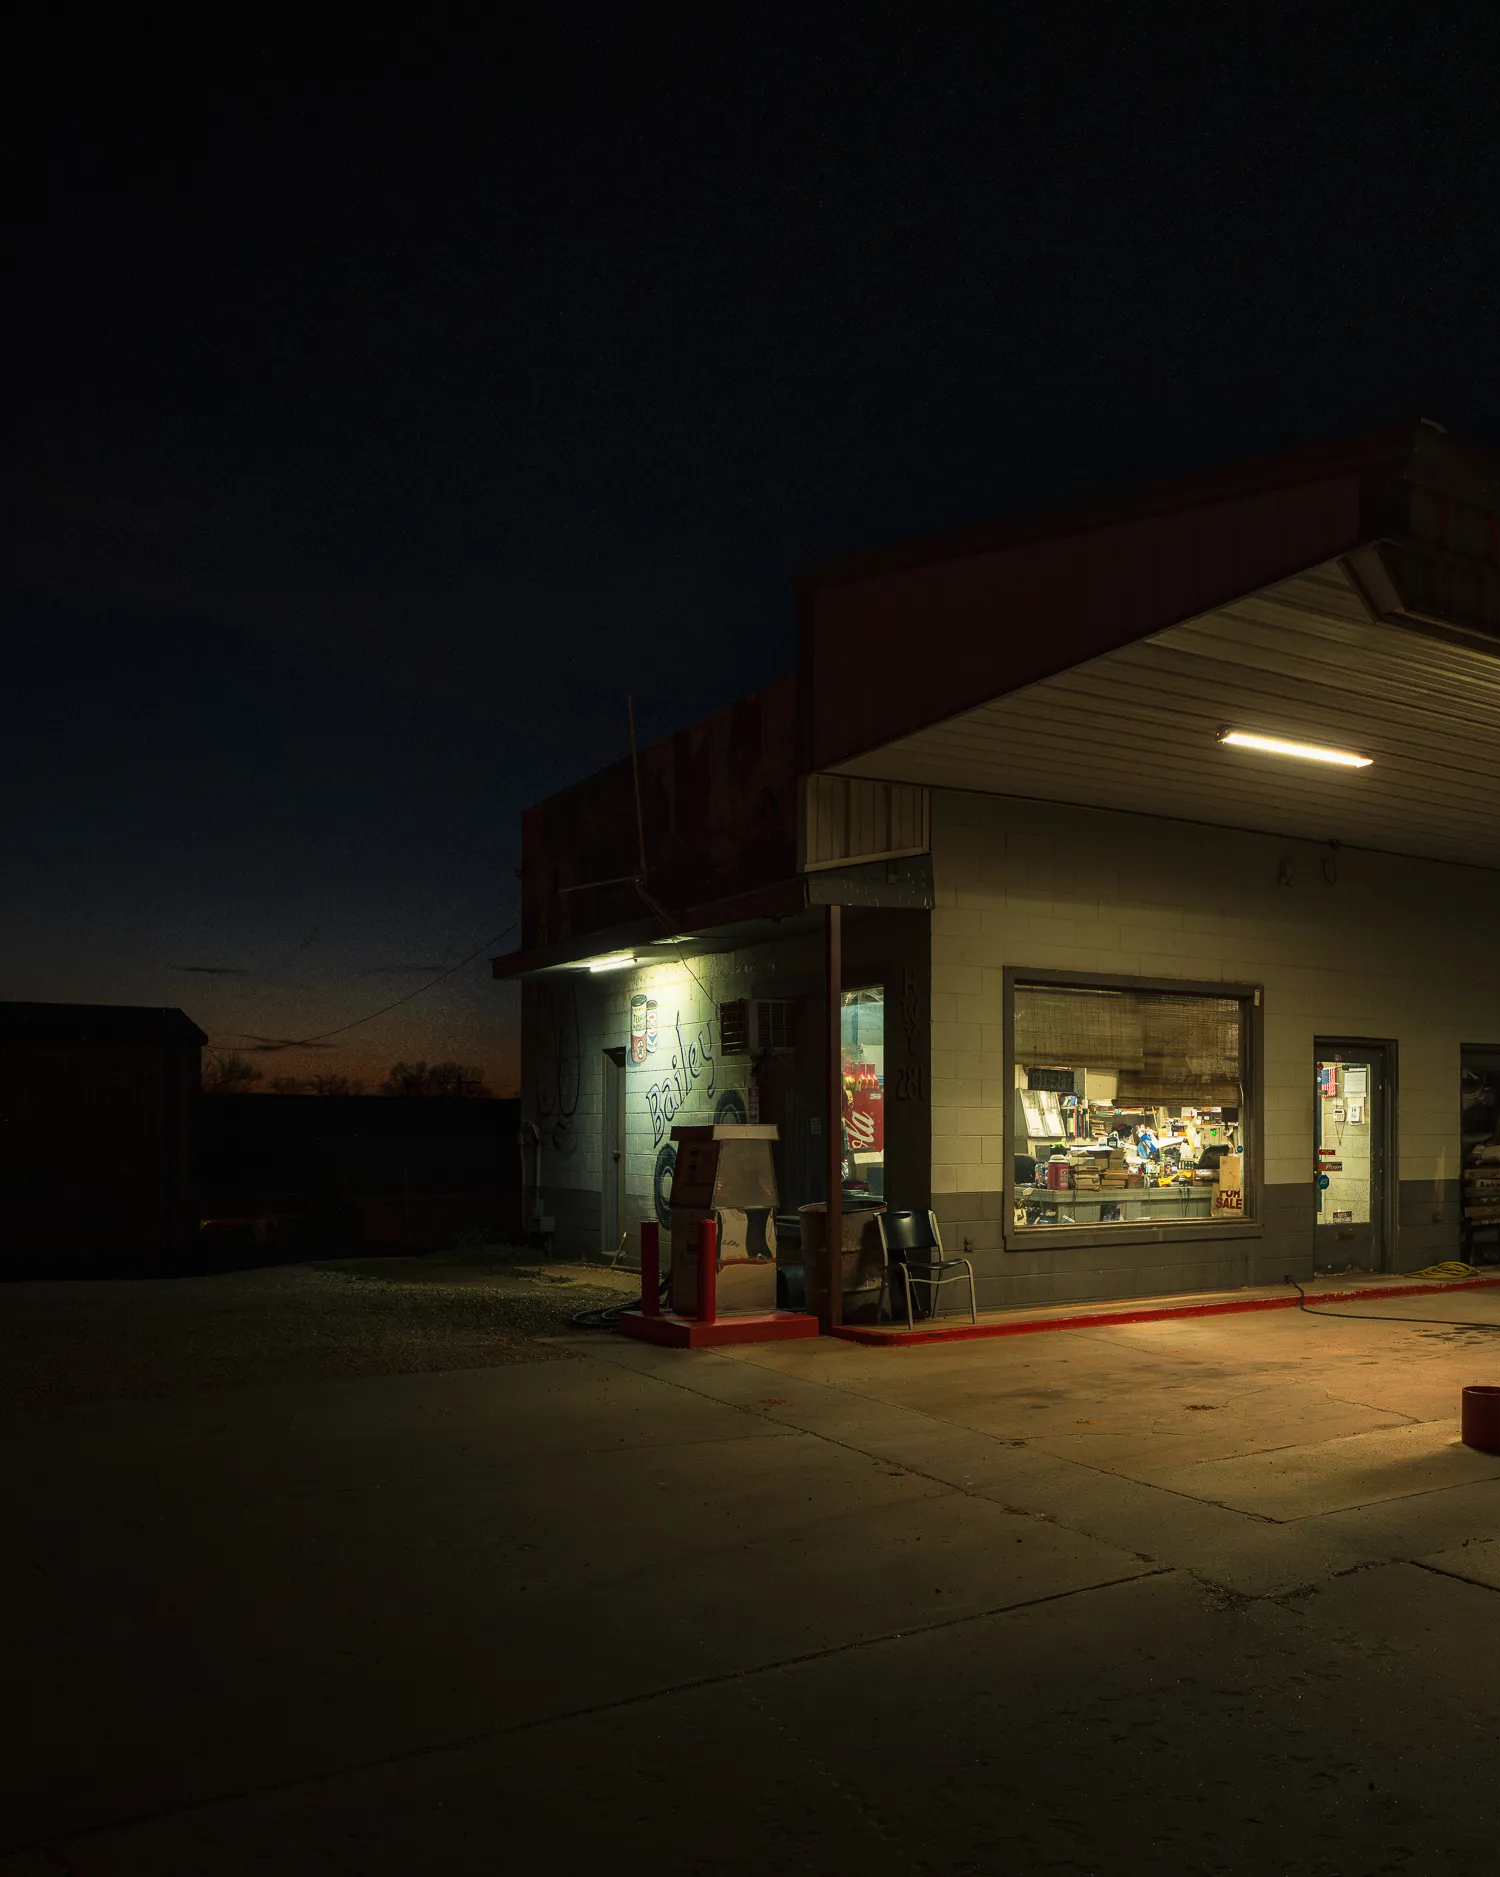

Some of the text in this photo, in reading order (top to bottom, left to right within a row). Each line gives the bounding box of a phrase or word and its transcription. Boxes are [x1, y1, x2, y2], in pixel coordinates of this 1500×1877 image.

[645, 1011, 715, 1149] Bailey
[896, 1065, 924, 1101] 281
[1216, 1198, 1243, 1209] SALE
